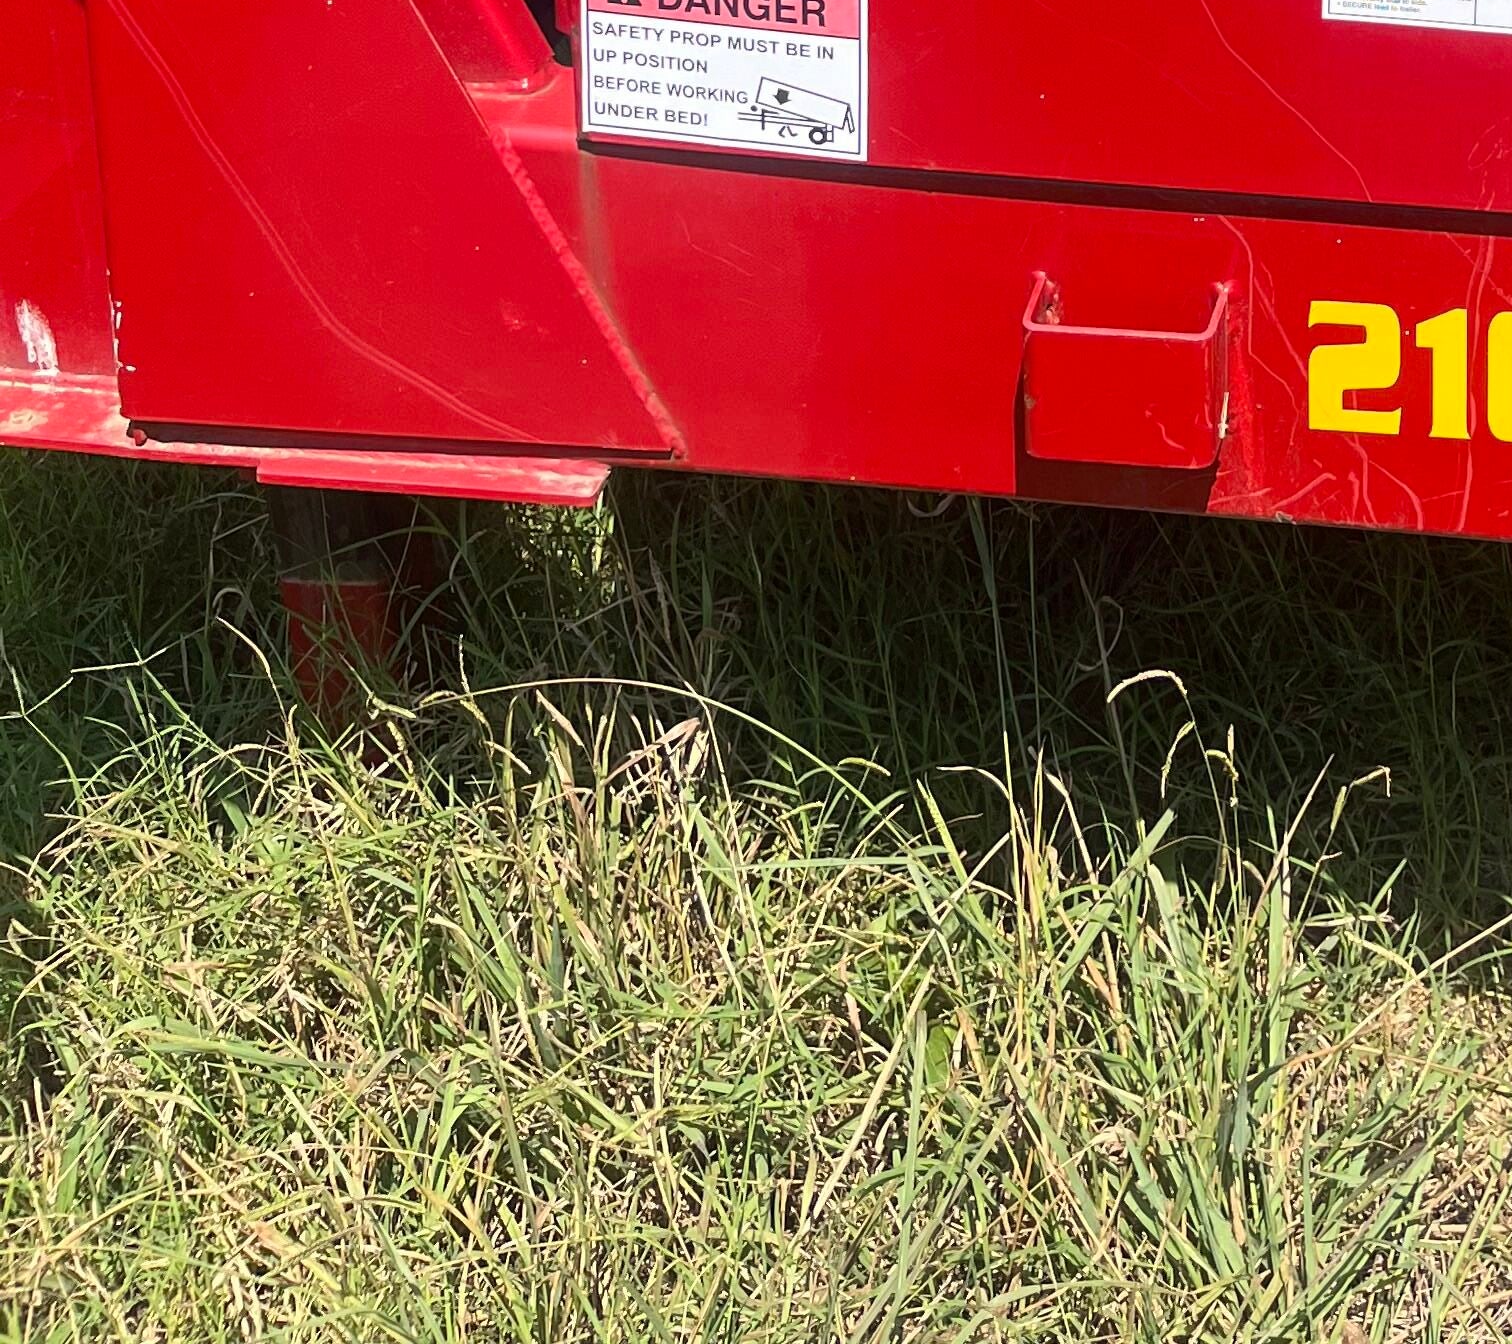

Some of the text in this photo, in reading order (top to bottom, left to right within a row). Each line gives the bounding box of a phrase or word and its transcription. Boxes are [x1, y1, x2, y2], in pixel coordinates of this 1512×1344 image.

[592, 21, 834, 60] SAFETY PROP MUST BE IN
[593, 48, 708, 74] UP POSITION
[593, 75, 749, 105] BEFORE WORKING
[594, 101, 708, 126] UNDER BED!
